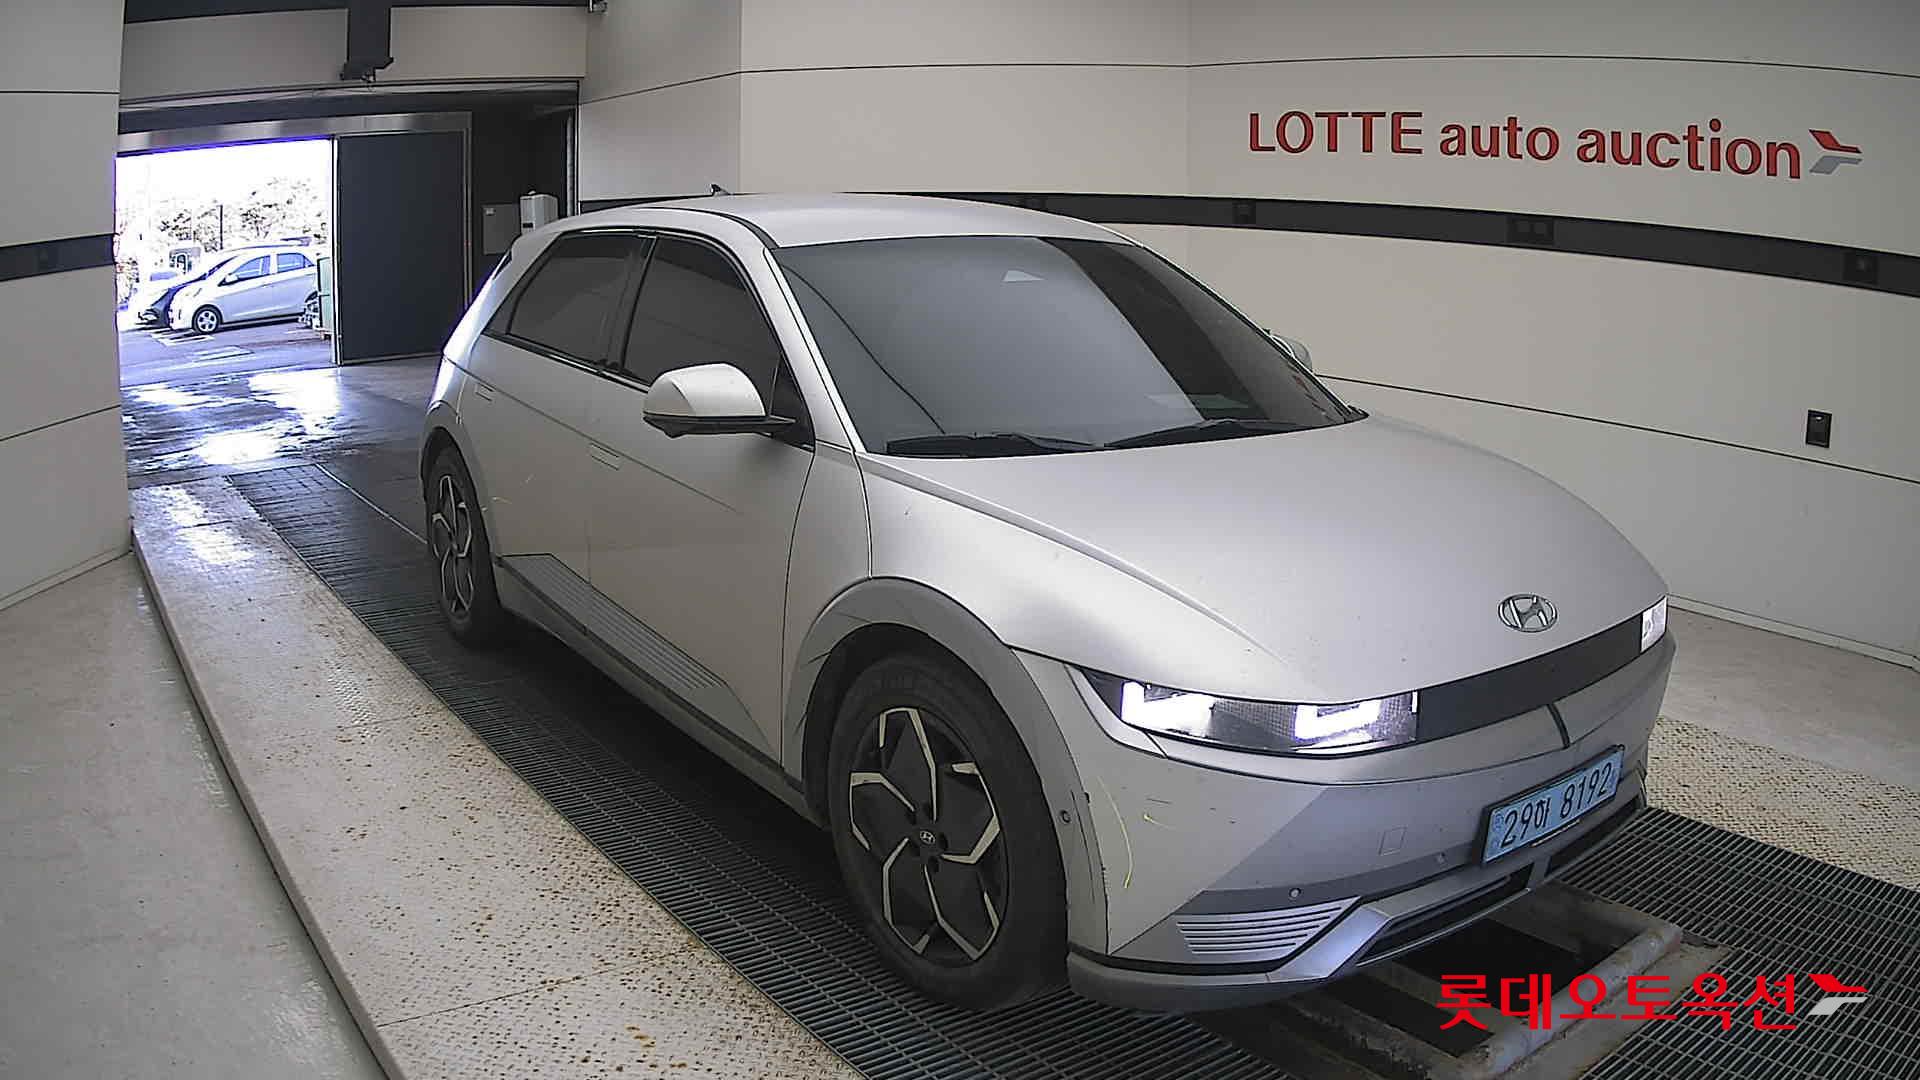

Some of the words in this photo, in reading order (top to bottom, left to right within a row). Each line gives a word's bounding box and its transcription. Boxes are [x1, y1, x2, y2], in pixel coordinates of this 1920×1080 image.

[1249, 111, 1424, 155] LOTTE
[1439, 116, 1560, 162] auto
[1576, 118, 1801, 179] auction
[1500, 797, 1551, 849] 29하
[1560, 762, 1613, 819] 8192
